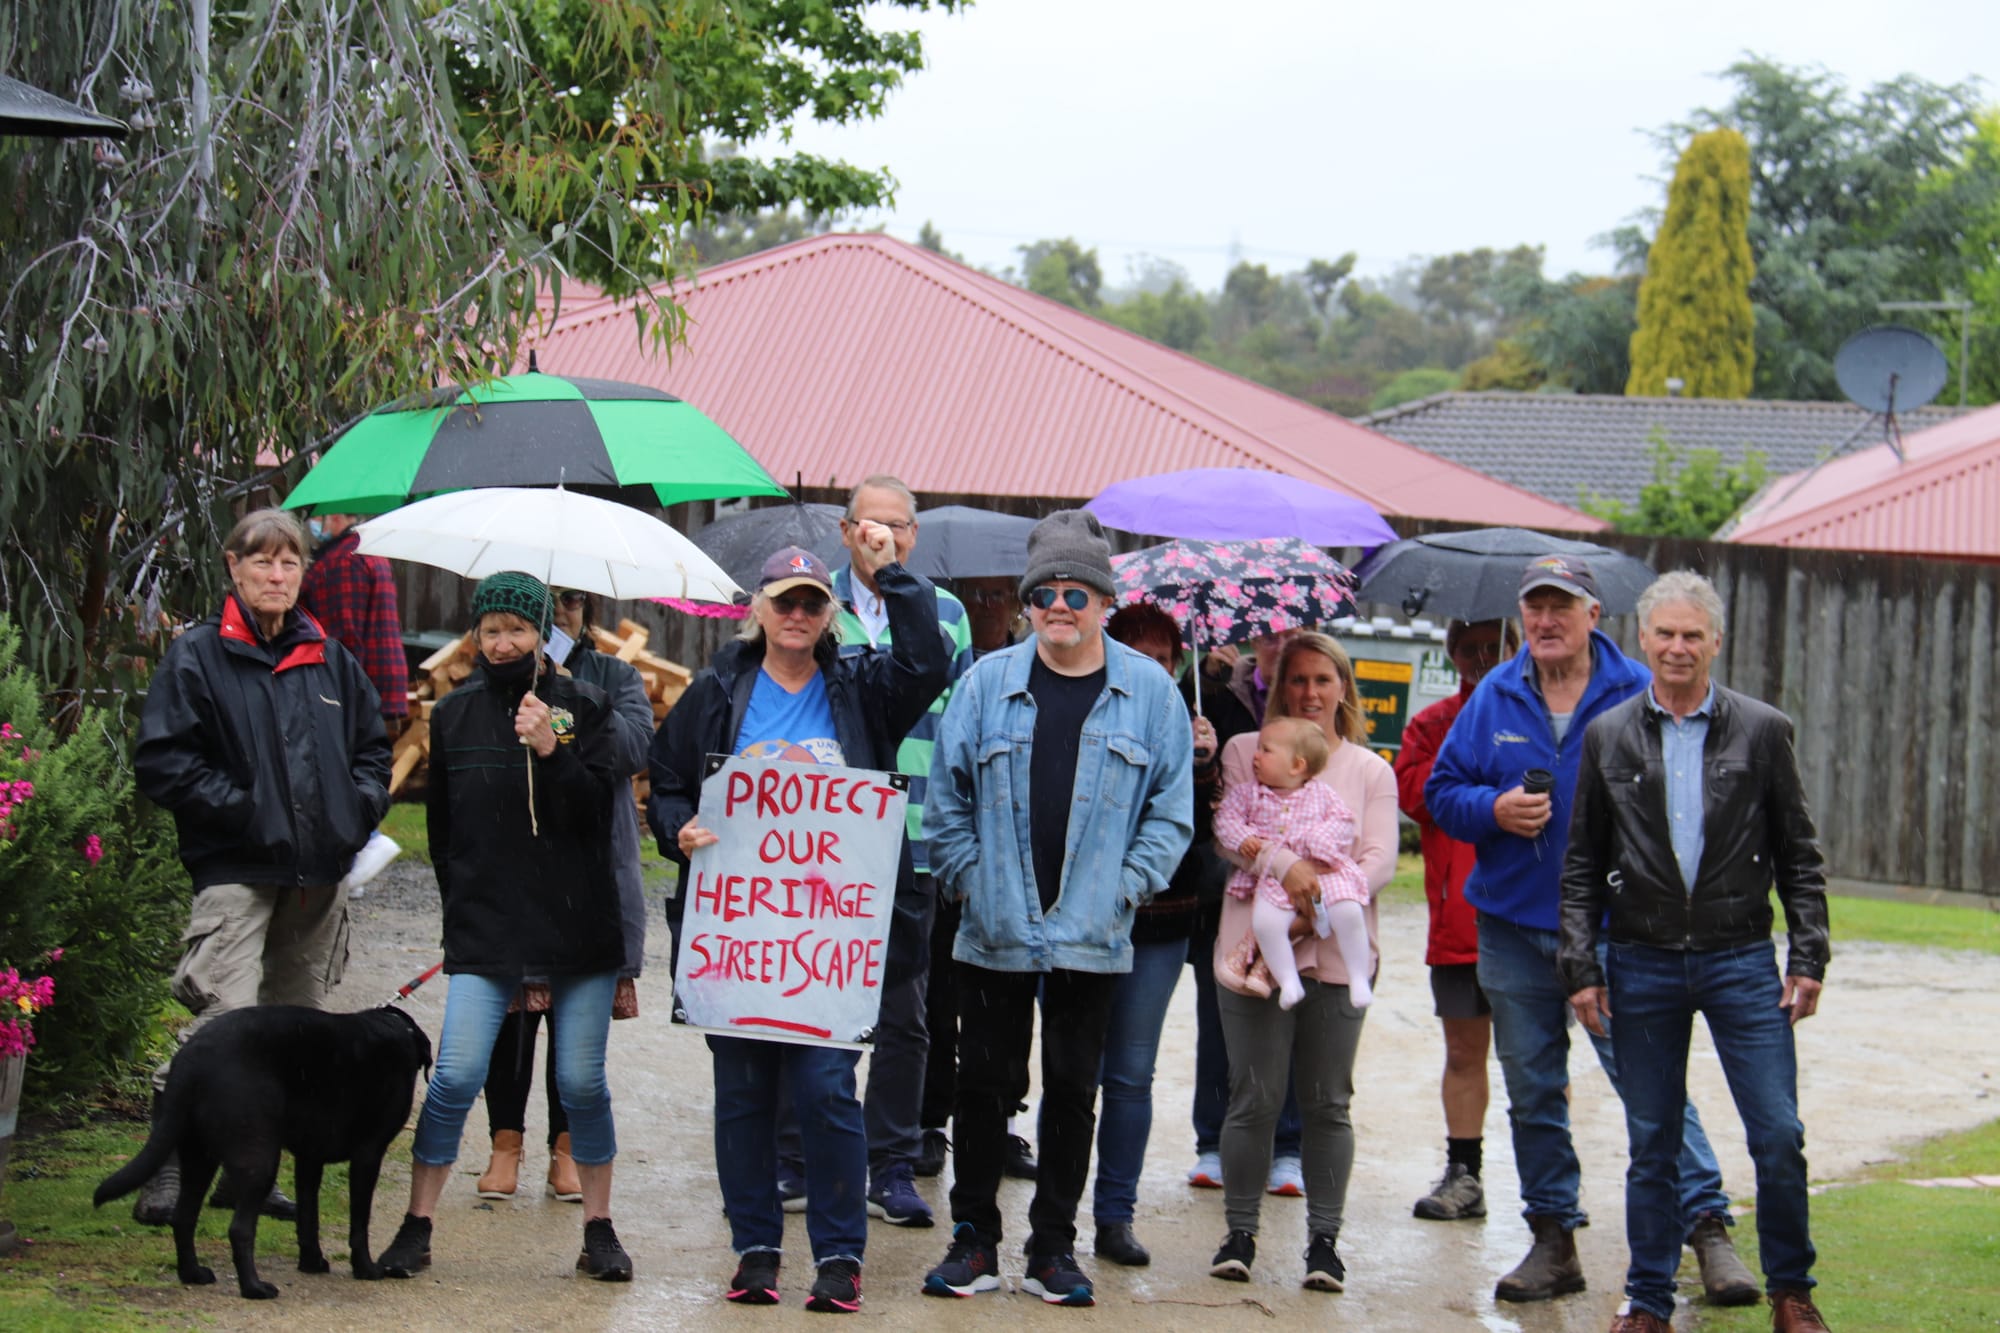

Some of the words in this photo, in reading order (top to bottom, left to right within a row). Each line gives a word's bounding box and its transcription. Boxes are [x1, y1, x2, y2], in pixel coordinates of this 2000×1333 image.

[725, 768, 898, 819] PROTECT
[759, 829, 842, 864] OUR
[695, 872, 876, 922] HERITAGE
[688, 929, 882, 997] STREETSCAPE
